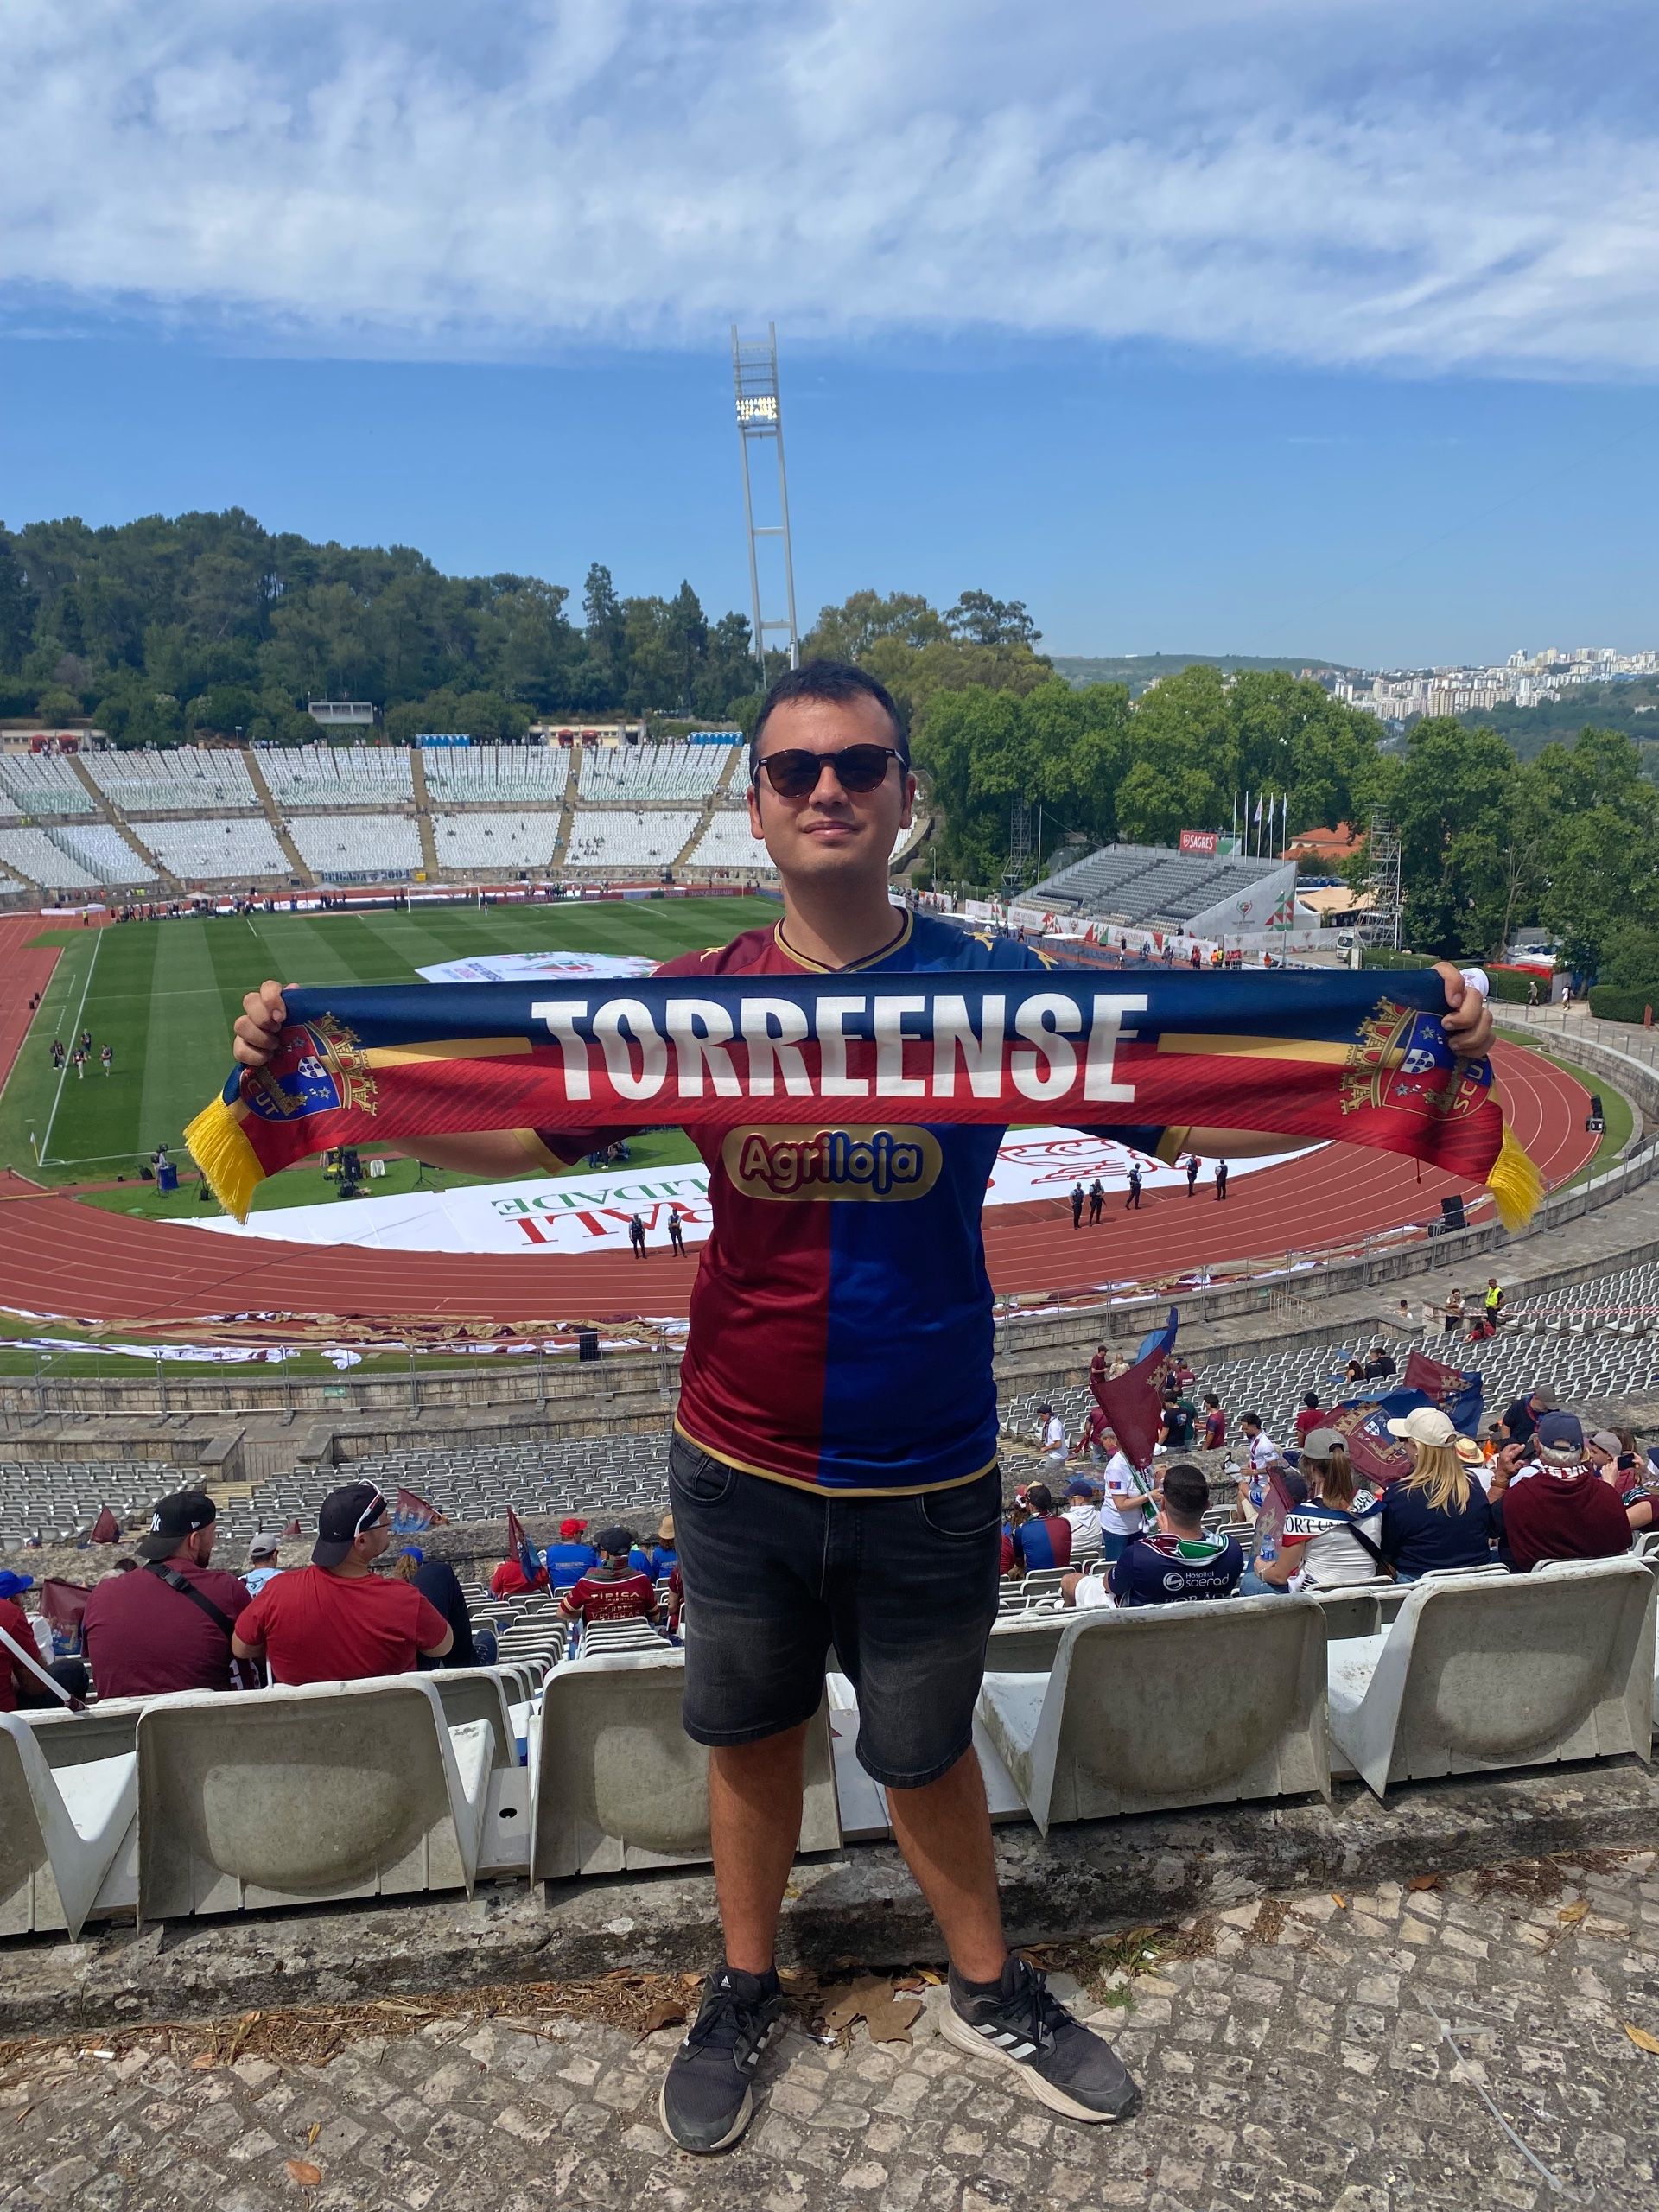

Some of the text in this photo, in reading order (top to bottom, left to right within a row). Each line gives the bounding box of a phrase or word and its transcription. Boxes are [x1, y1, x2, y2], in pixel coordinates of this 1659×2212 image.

[1190, 834, 1214, 850] SAGRES
[531, 993, 1148, 1103] TORREENSE
[245, 1072, 279, 1115] CUT
[1453, 1057, 1487, 1113] SCU
[740, 1130, 923, 1195] Agriloja
[1185, 1573, 1230, 1588] soerad
